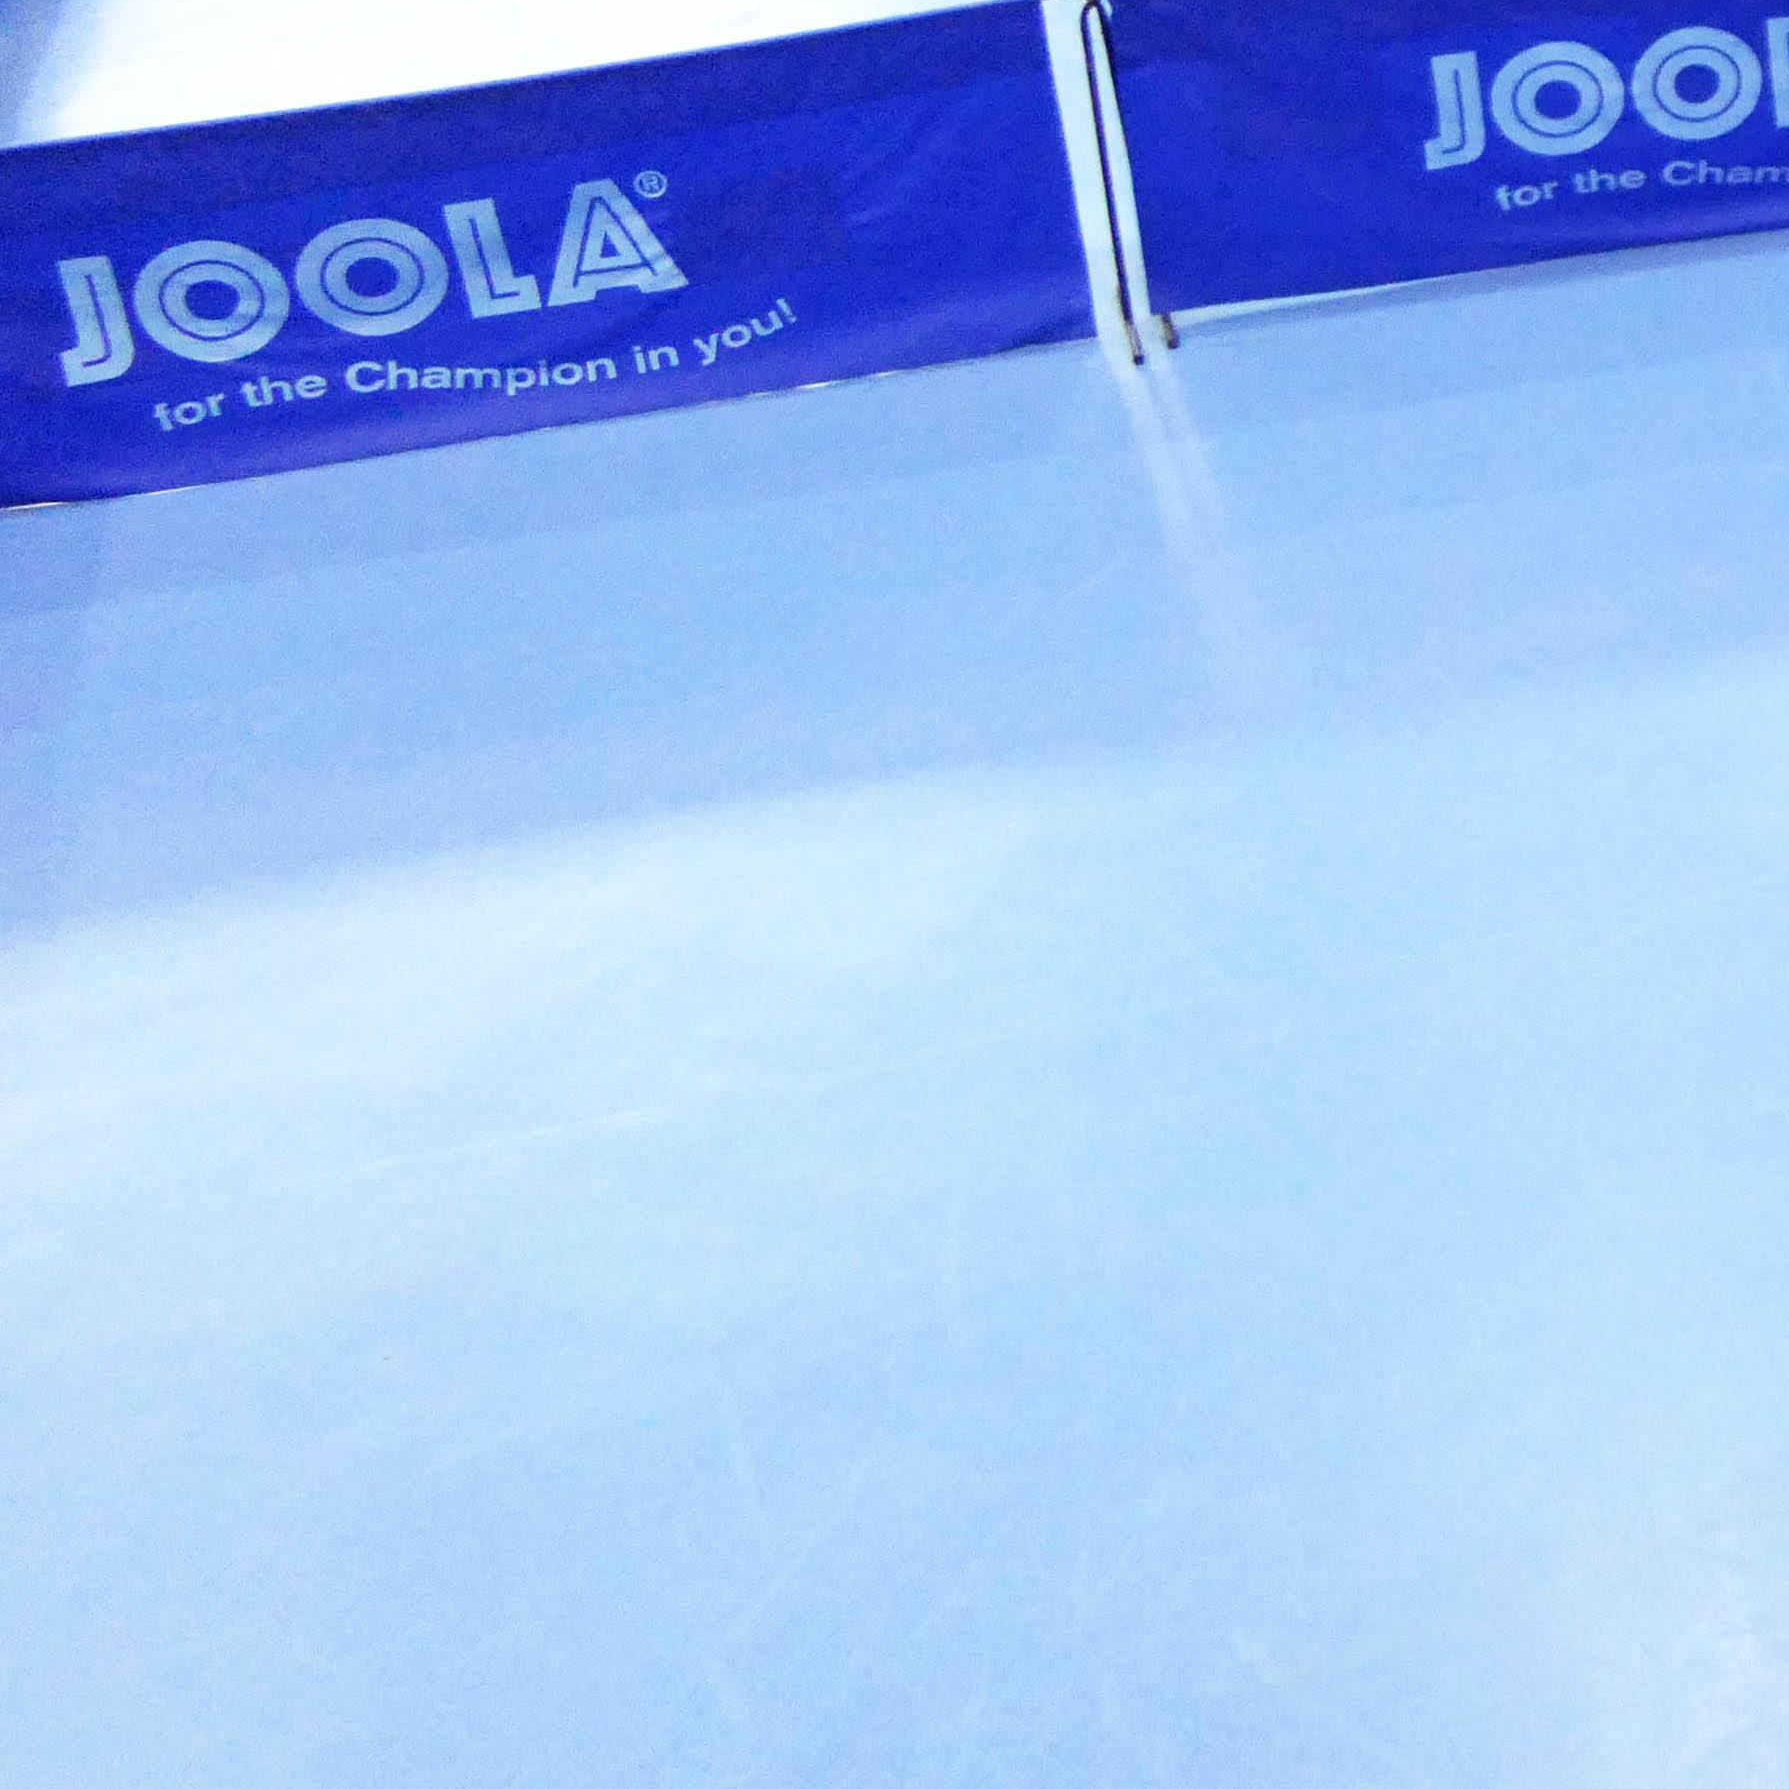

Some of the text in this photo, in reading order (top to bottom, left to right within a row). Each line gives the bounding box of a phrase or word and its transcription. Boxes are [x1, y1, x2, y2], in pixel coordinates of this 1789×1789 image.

[1494, 177, 1558, 211] for
[1572, 166, 1647, 193] the
[58, 177, 689, 388] JOOLA
[152, 297, 799, 433] for the Champion in you!
